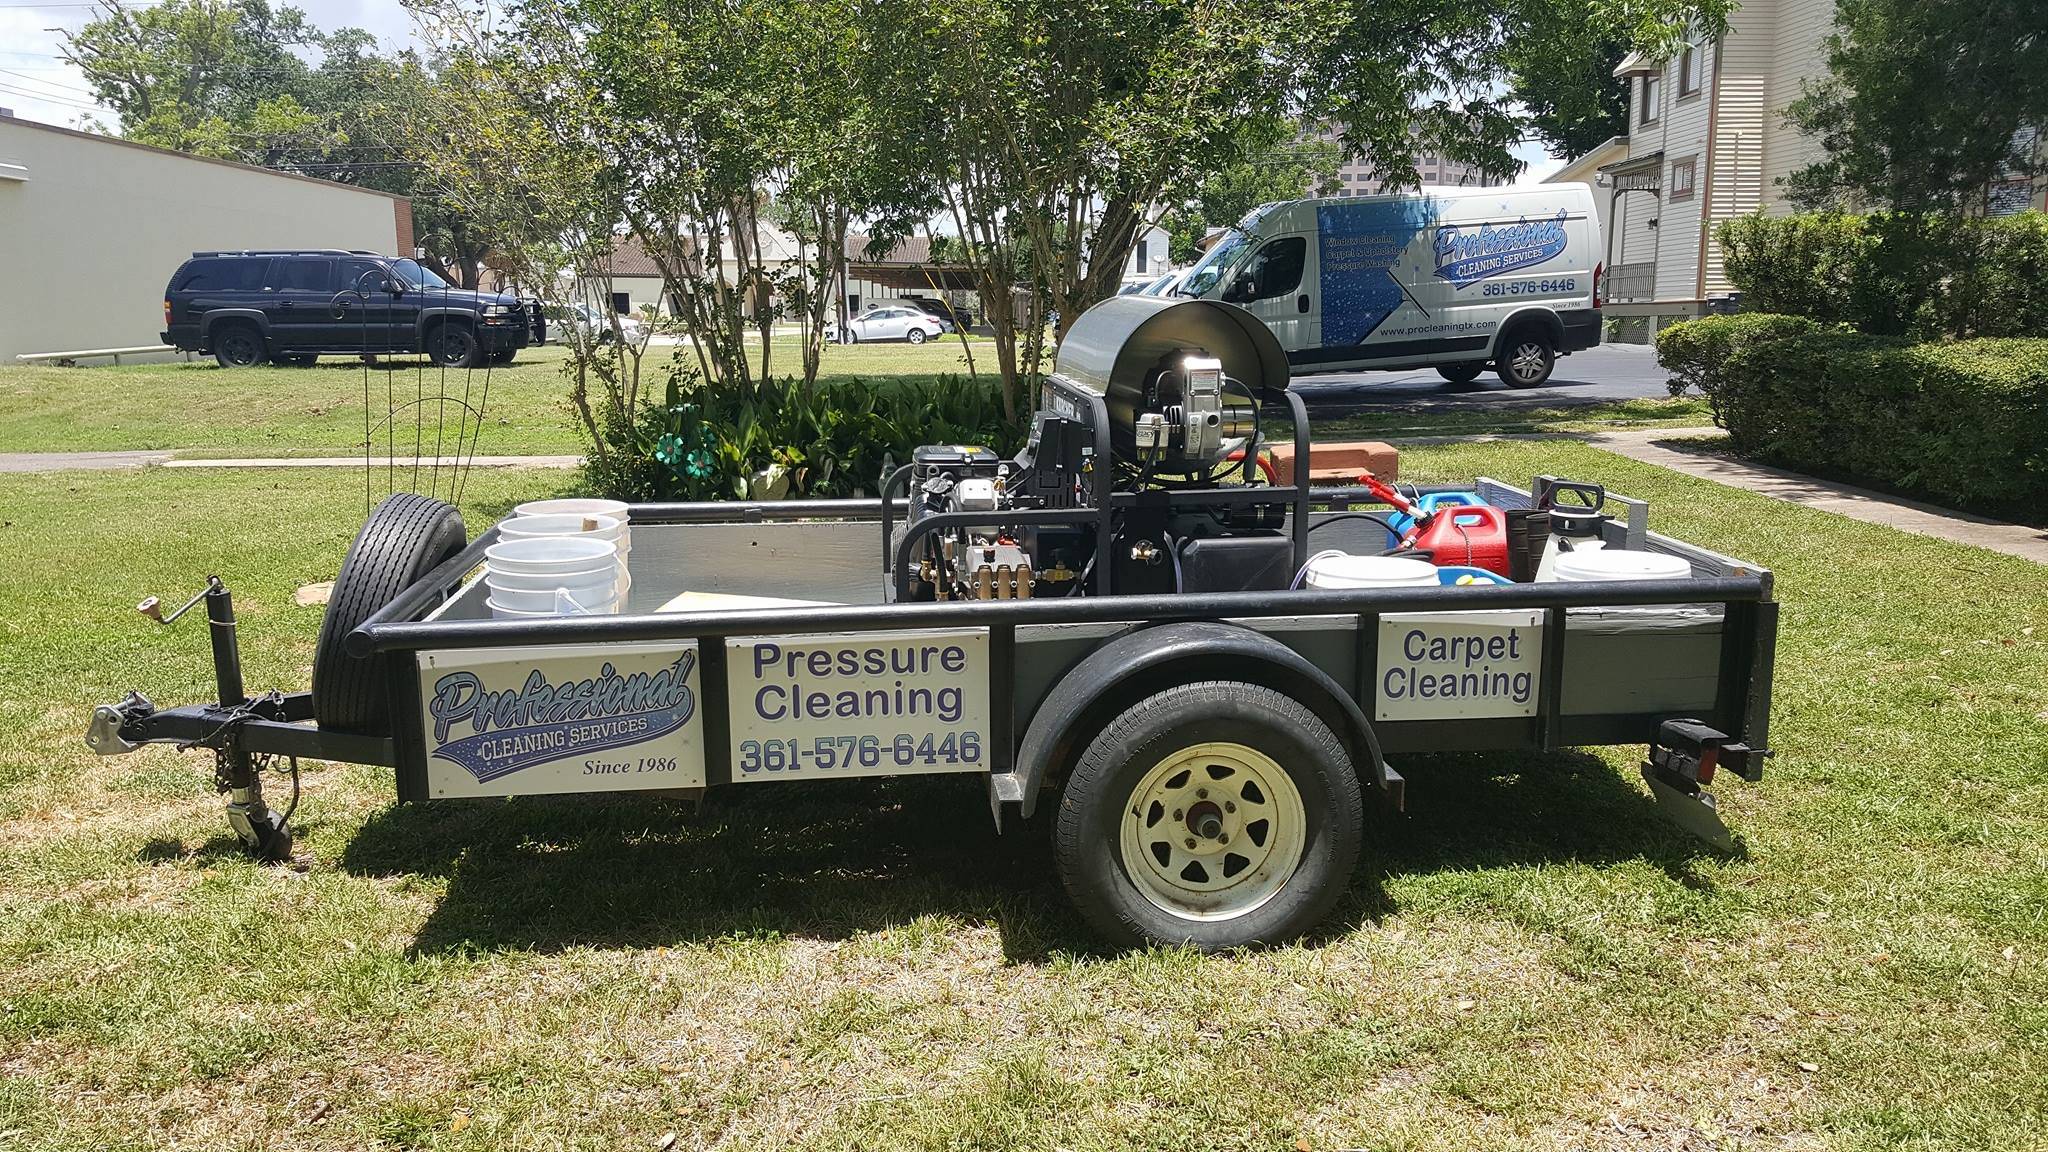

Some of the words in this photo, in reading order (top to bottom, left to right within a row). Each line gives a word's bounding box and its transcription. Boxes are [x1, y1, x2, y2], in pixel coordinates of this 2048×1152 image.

[1360, 234, 1395, 245] Cleaning
[1433, 208, 1567, 269] Professional
[1458, 257, 1501, 278] CLEANING
[1503, 248, 1543, 265] SERVICES
[1482, 279, 1575, 297] 361-576-6446
[1380, 319, 1497, 336] www.procleaningtx.com
[754, 643, 965, 679] Pressure
[1404, 628, 1520, 668] Carpet
[430, 648, 696, 744] Professional
[755, 680, 963, 722] Cleaning
[1383, 665, 1532, 703] Cleaning
[481, 730, 565, 761] CLEANING
[570, 717, 648, 744] SERVICES
[740, 731, 981, 773] 361-576-6446
[583, 759, 631, 775] Since
[636, 757, 677, 773] 1986
